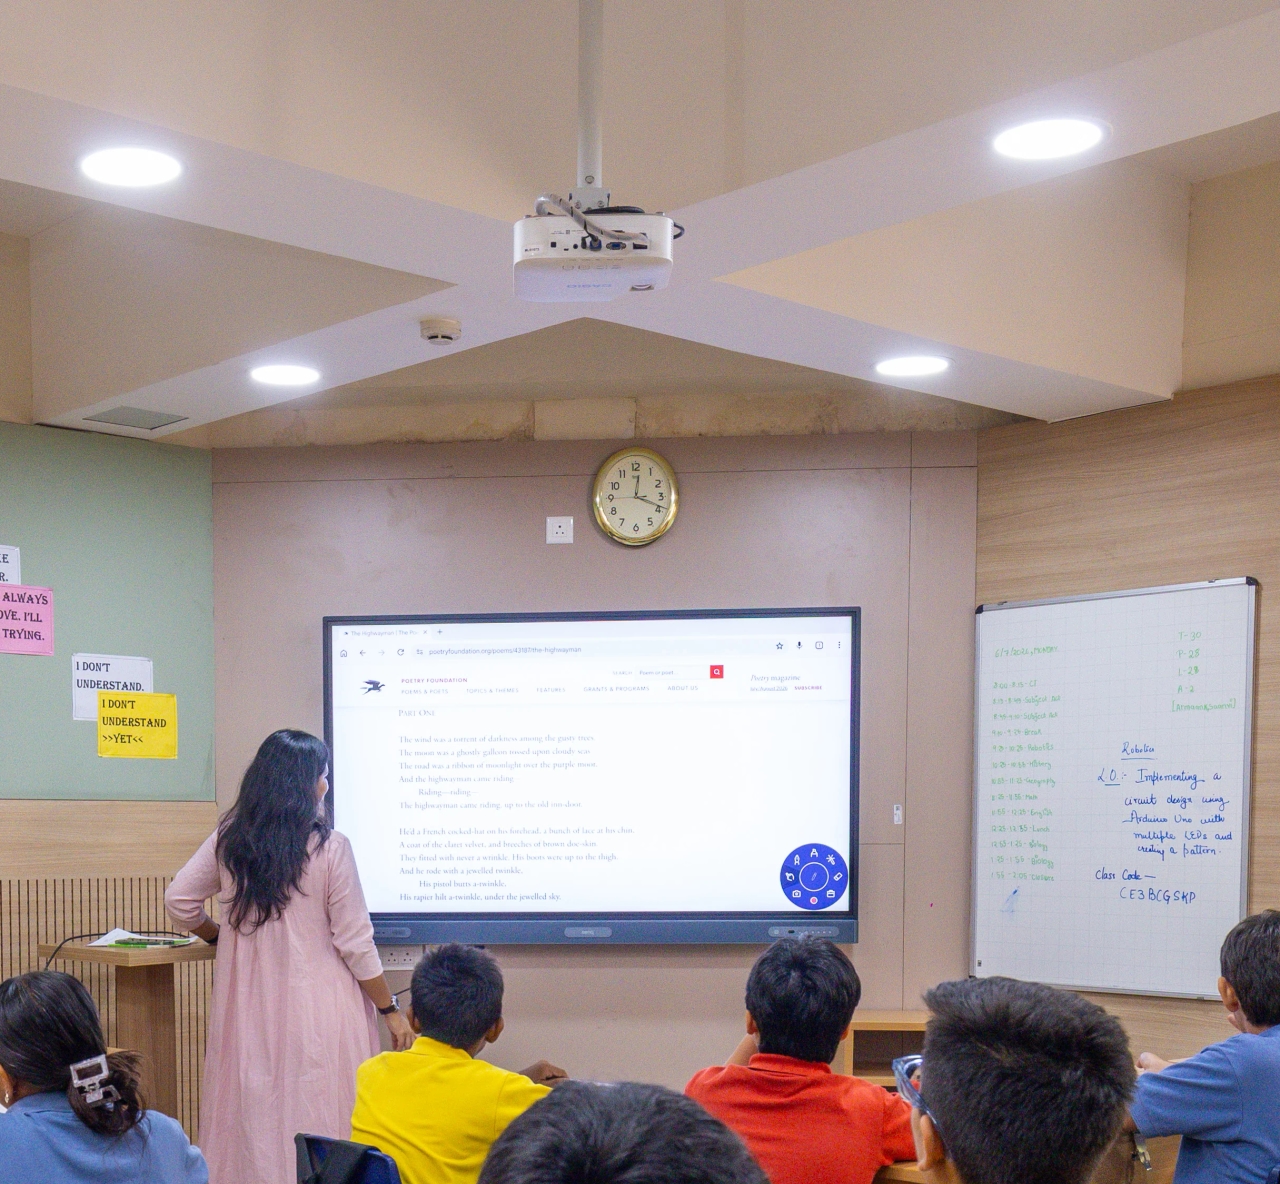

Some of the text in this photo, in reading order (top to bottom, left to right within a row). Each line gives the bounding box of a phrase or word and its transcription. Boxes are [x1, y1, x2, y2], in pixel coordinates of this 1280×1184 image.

[631, 463, 640, 471] 12
[649, 467, 652, 476] 1
[619, 470, 626, 478] 11
[611, 482, 620, 490] 10
[655, 479, 662, 488] 2
[608, 494, 614, 502] 9
[658, 492, 664, 501] 3
[611, 507, 617, 515] 8
[655, 505, 661, 513] 4
[619, 518, 625, 526] 7
[647, 517, 653, 526] 5
[633, 523, 639, 532] 6
[2, 592, 49, 605] ALWAYS
[24, 612, 43, 622] I'LL
[2, 628, 45, 640] TRYING.
[76, 661, 111, 673] I DON'T
[77, 679, 145, 691] UNDERSTAND.
[102, 699, 136, 709] I DON'T
[102, 716, 167, 727] UNDERSTAND
[1135, 768, 1205, 790] Implementing
[1213, 772, 1222, 781] a
[1124, 794, 1230, 812] circuit design using
[1122, 810, 1225, 824] Arduino Uno with
[1133, 830, 1176, 843] multiple
[1215, 832, 1233, 841] and
[1169, 847, 1178, 855] a
[1095, 867, 1116, 880] Class
[419, 880, 431, 888] His
[433, 880, 452, 890] pistol
[400, 893, 412, 901] His
[413, 894, 433, 902] rapier
[435, 893, 447, 901] hilt
[484, 893, 505, 901] under
[506, 893, 518, 901] the
[519, 893, 547, 902] jewelled
